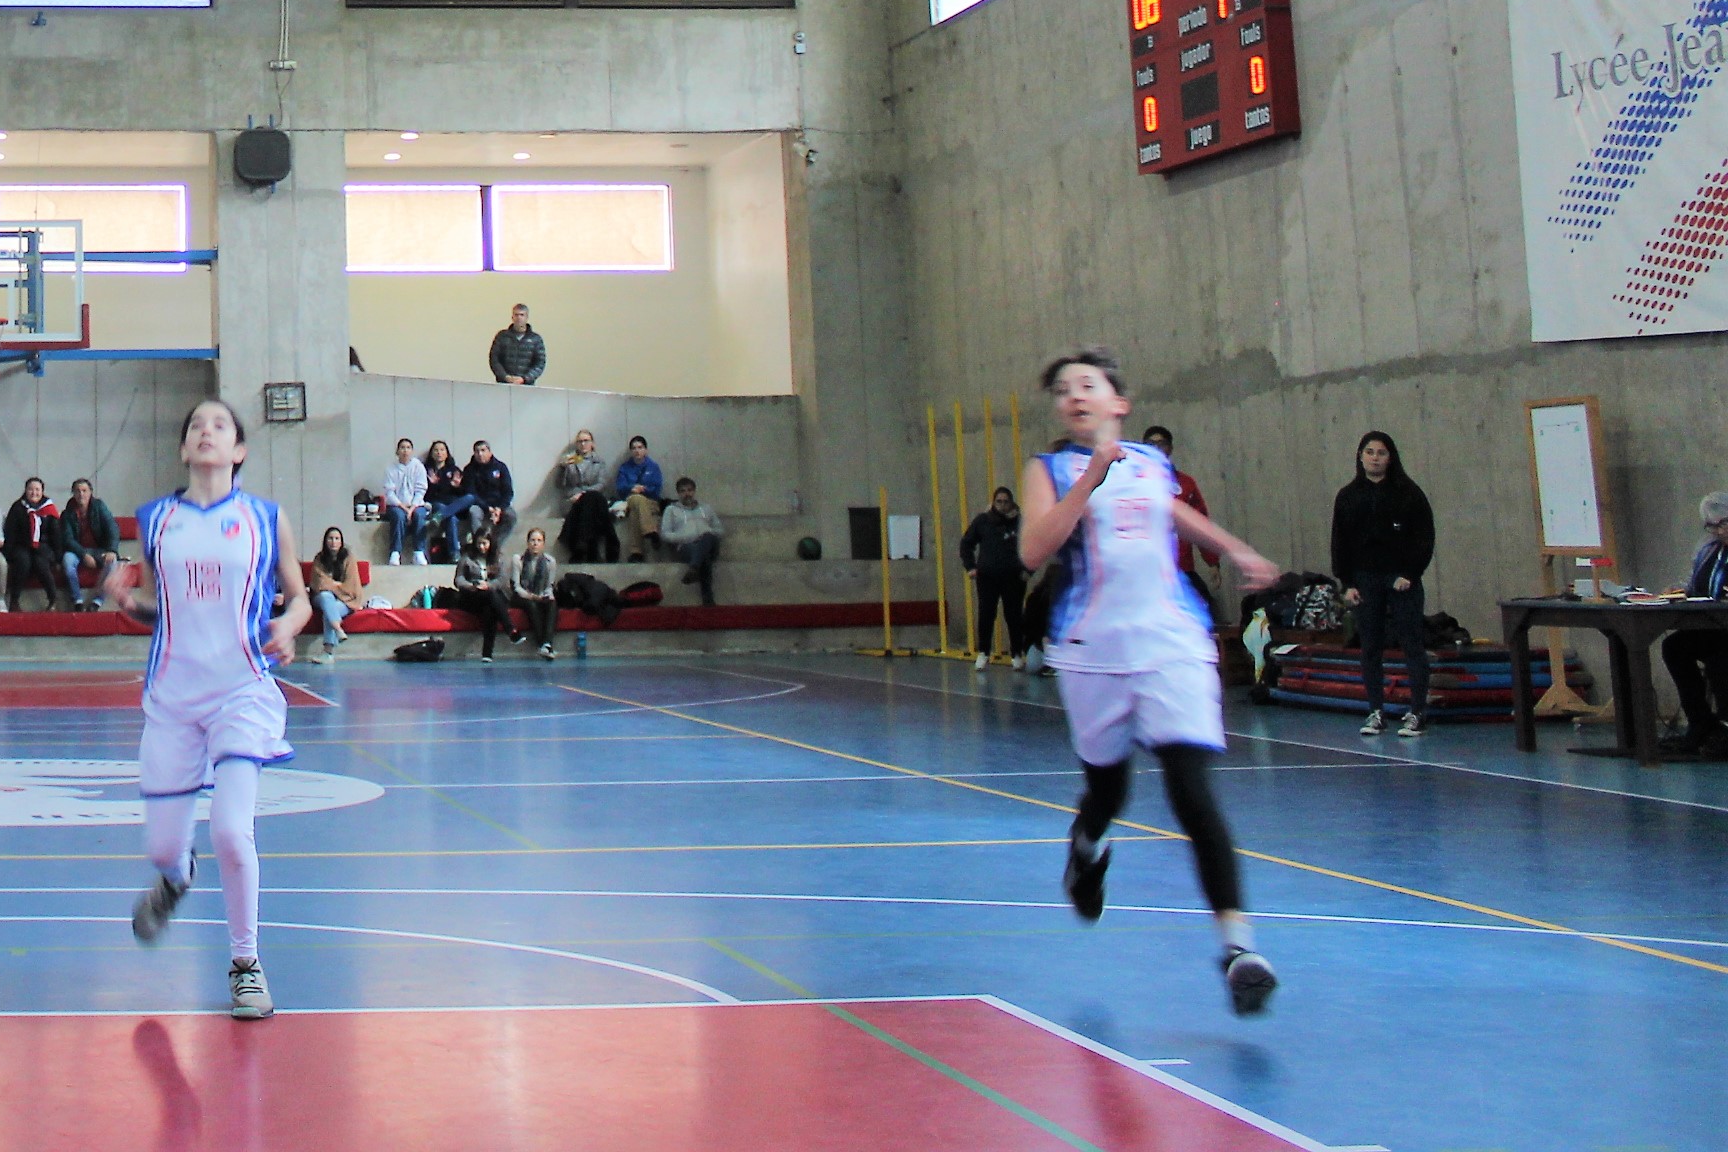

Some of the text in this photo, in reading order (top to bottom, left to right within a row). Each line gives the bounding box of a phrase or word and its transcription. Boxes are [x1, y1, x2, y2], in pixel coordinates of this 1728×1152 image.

[1250, 55, 1267, 95] 0
[1550, 33, 1650, 114] Lycée
[1144, 96, 1160, 133] 0
